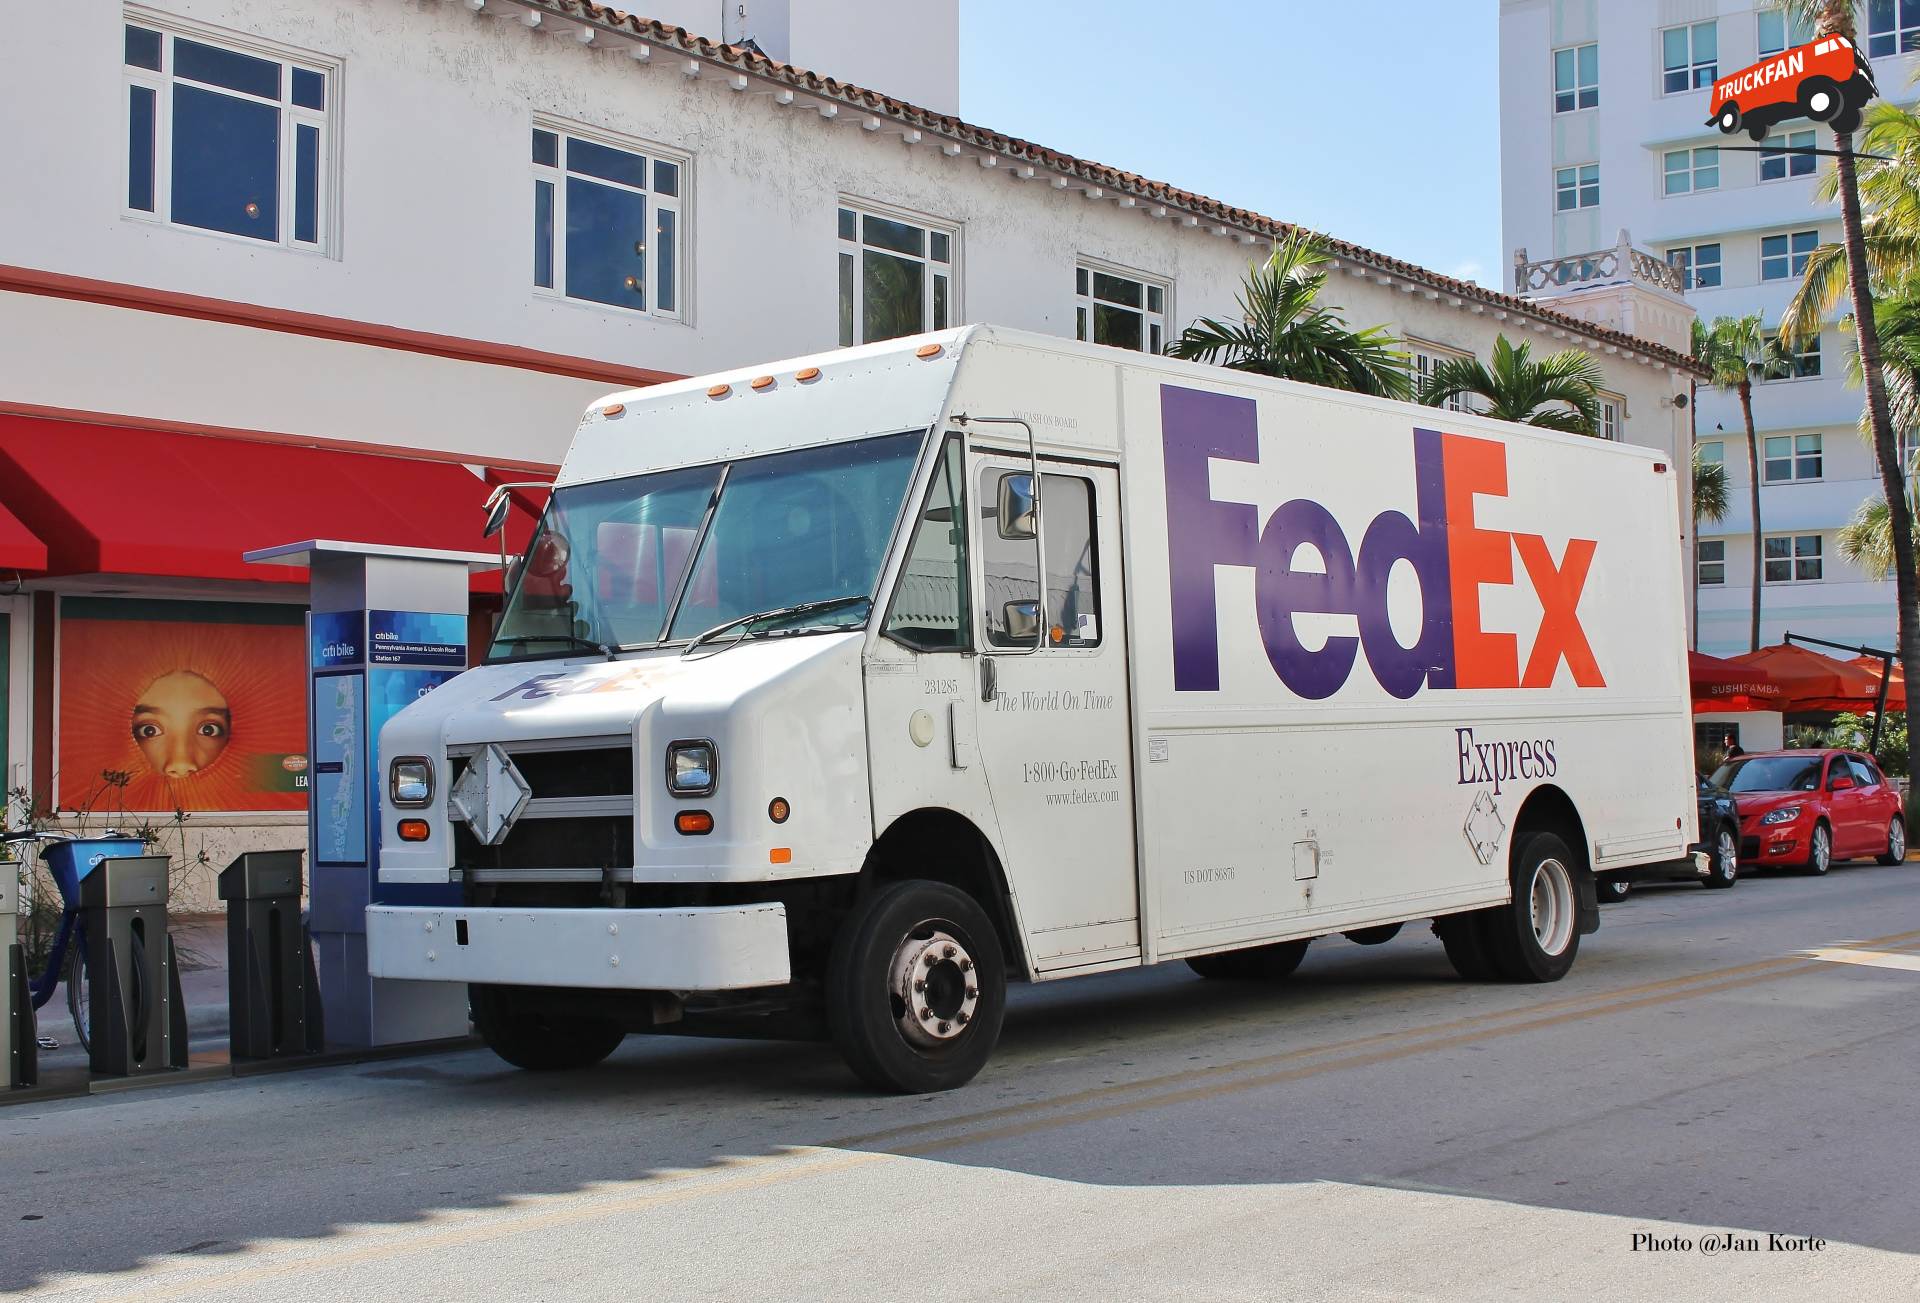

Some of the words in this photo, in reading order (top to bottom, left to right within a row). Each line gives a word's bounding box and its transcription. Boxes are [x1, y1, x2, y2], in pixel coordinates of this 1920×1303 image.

[1023, 411, 1042, 425] CASH
[1043, 414, 1053, 426] ON
[1054, 416, 1078, 429] BOARD
[1159, 383, 1607, 700] FedEx
[322, 643, 336, 657] citi
[336, 643, 355, 656] bike
[375, 643, 406, 652] Pennsylvania
[924, 679, 958, 695] 231285
[1711, 683, 1780, 694] SUSHISAMBA
[995, 691, 1018, 712] The
[1022, 690, 1059, 711] World
[1062, 690, 1080, 711] On
[1083, 690, 1113, 710] Time
[1455, 727, 1557, 796] Express
[1046, 788, 1120, 806] www.fedex.com
[1184, 870, 1195, 884] US
[1196, 868, 1213, 883] DOT
